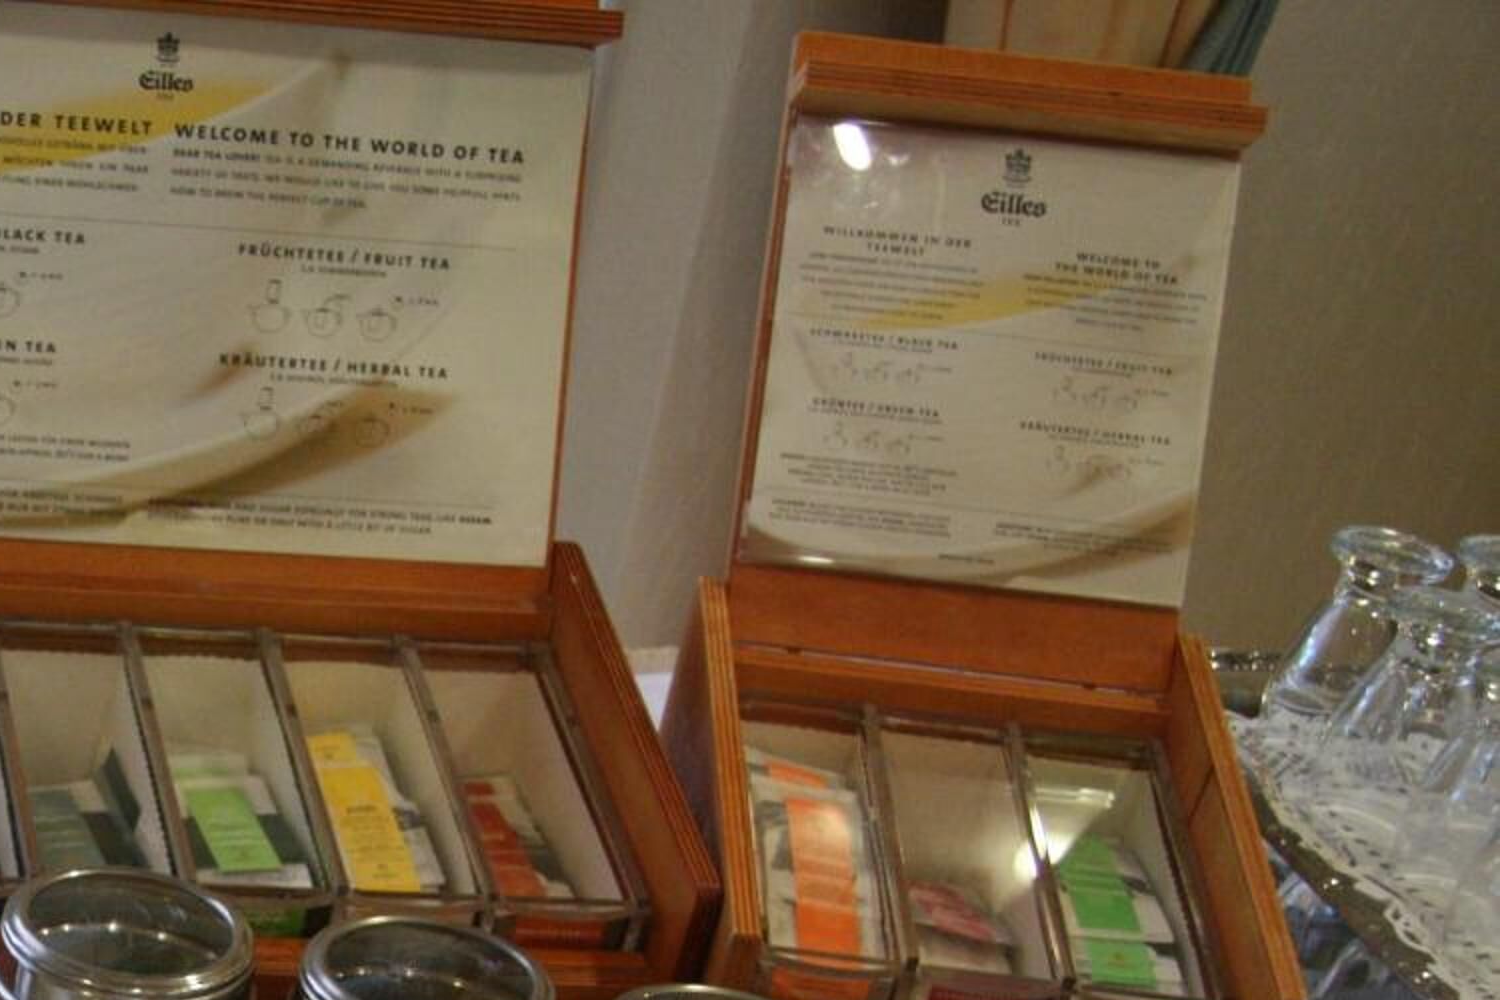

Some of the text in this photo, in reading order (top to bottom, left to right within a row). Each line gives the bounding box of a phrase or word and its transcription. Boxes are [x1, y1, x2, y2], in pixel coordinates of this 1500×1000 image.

[0, 111, 41, 129] DER
[54, 114, 153, 136] TEEWELT
[175, 124, 525, 165] WELCOME TO THE WORLD OF TEA
[981, 190, 1047, 218] Eilles
[54, 230, 86, 246] TEA
[238, 241, 347, 263] FRÜCHTETEE
[364, 252, 412, 268] FRUIT
[419, 255, 450, 271] TEA
[25, 339, 57, 354] TEA
[219, 351, 328, 373] KRÄUTERTEE
[347, 360, 410, 378] HERBAL
[418, 365, 448, 380] TEA
